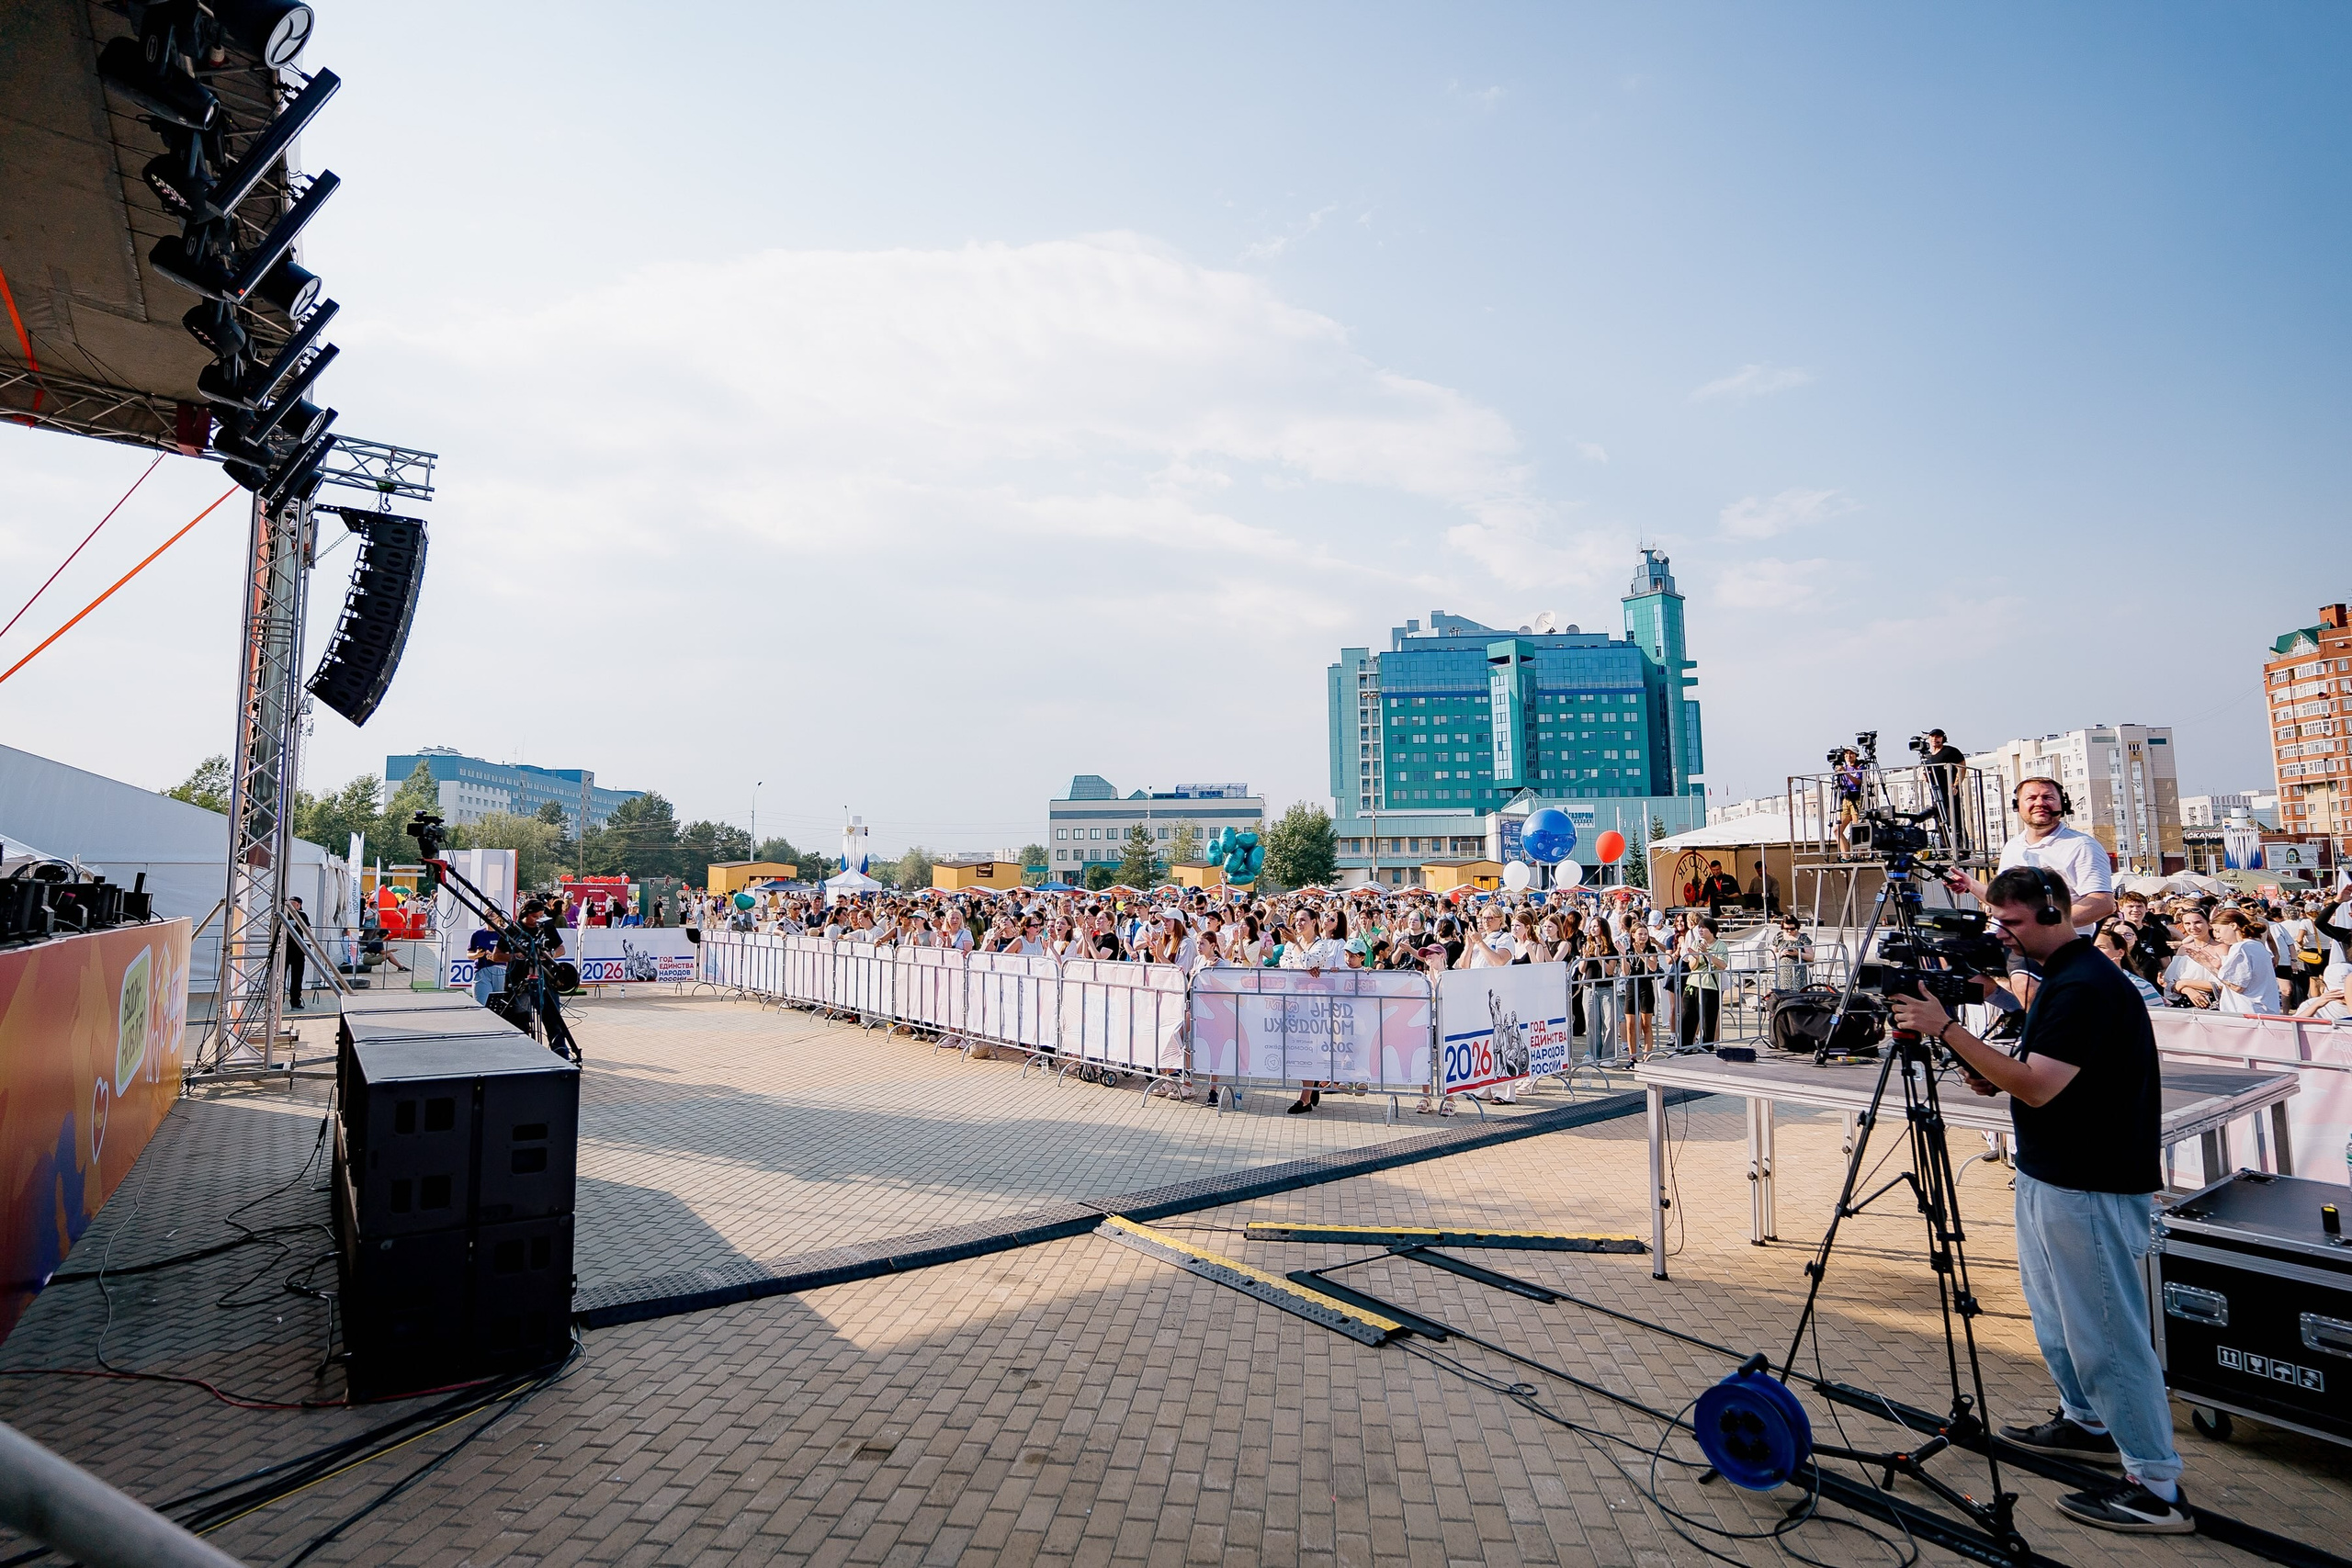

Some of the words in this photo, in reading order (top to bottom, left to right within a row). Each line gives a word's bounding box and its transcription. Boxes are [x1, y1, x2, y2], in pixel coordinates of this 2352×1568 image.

[450, 965, 474, 982] 20
[582, 962, 623, 980] 2026
[1530, 1021, 1545, 1033] ГОД
[1530, 1031, 1567, 1048] ЕДИНСТВА
[1445, 1039, 1493, 1083] 2026
[1530, 1045, 1566, 1062] НАРОДОВ
[1531, 1059, 1562, 1076] РОССИИ
